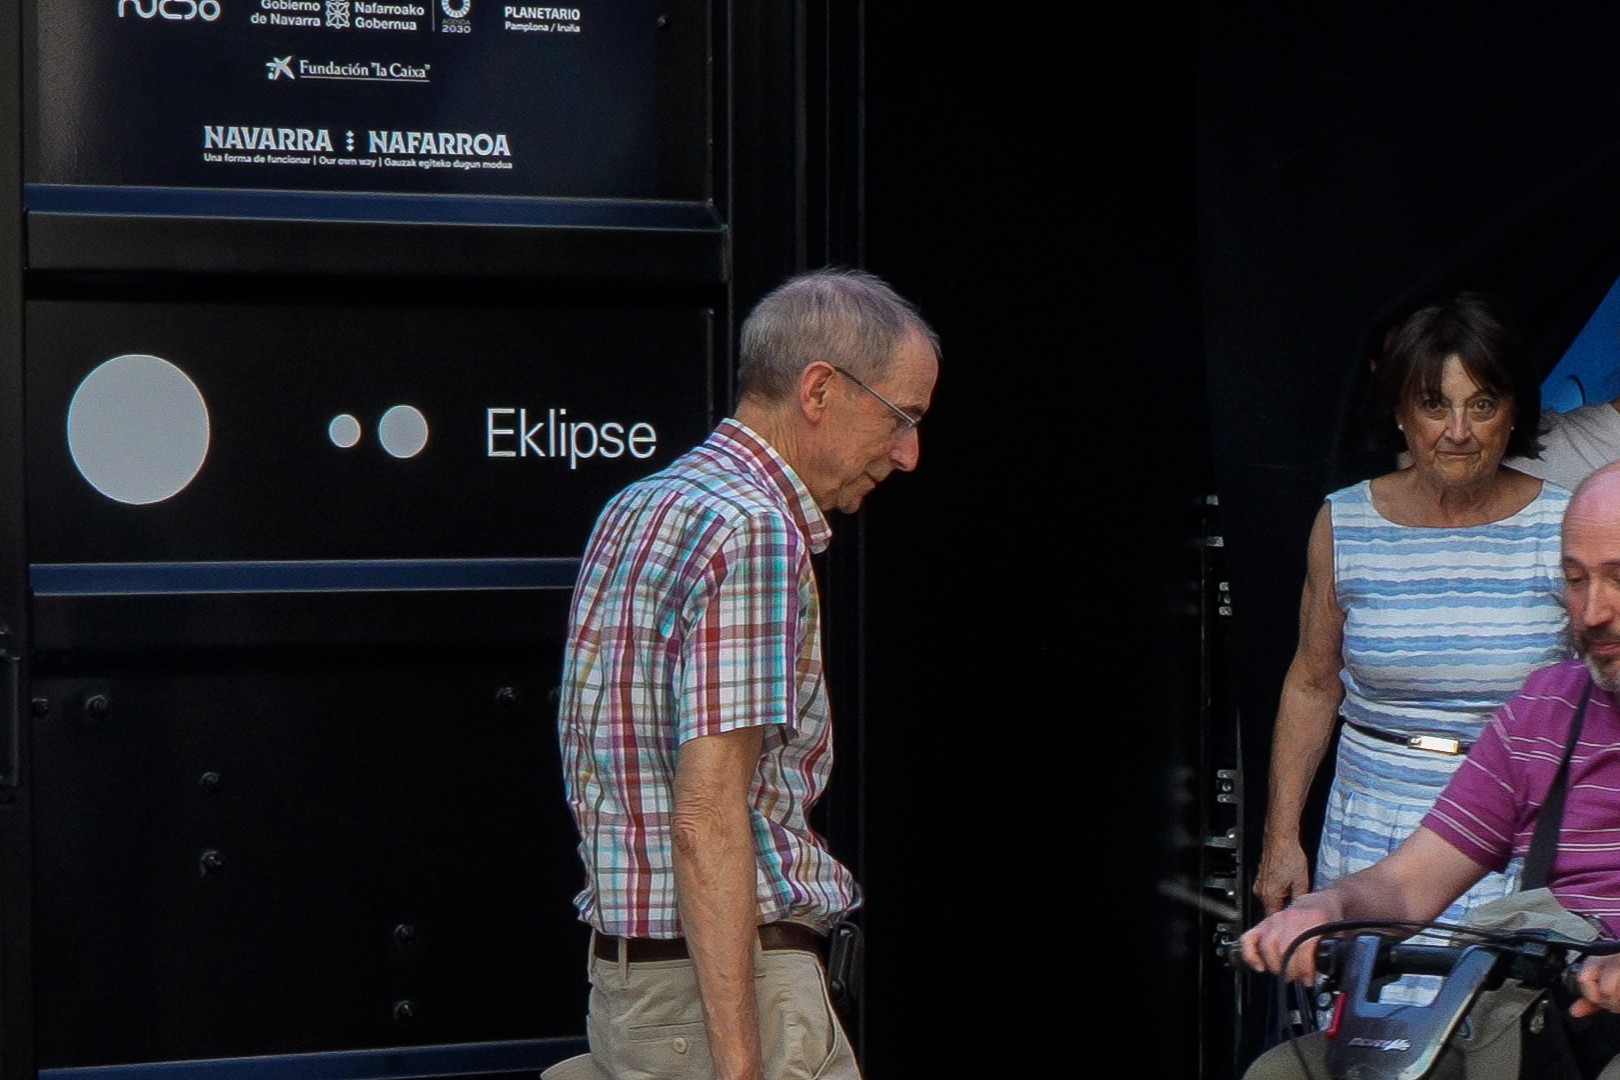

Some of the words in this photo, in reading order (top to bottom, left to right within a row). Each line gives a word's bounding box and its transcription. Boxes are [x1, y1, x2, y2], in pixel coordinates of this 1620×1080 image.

[261, 0, 321, 11] Gobierno
[355, 1, 425, 16] Nafarroako
[250, 13, 268, 25] de
[270, 14, 321, 27] Navarra
[504, 6, 581, 21] PLANETARIO
[355, 17, 417, 31] Gobernua
[441, 24, 472, 33] 2030
[504, 21, 549, 33] Pamplona
[300, 59, 369, 76] Fundación
[204, 125, 334, 152] NAVARRA
[368, 130, 512, 157] NAFARROA
[203, 153, 223, 162] Una
[224, 153, 251, 163] forma
[253, 154, 266, 164] de
[267, 154, 311, 165] funcionar
[318, 156, 336, 165] Our
[487, 407, 657, 470] Eklipse
